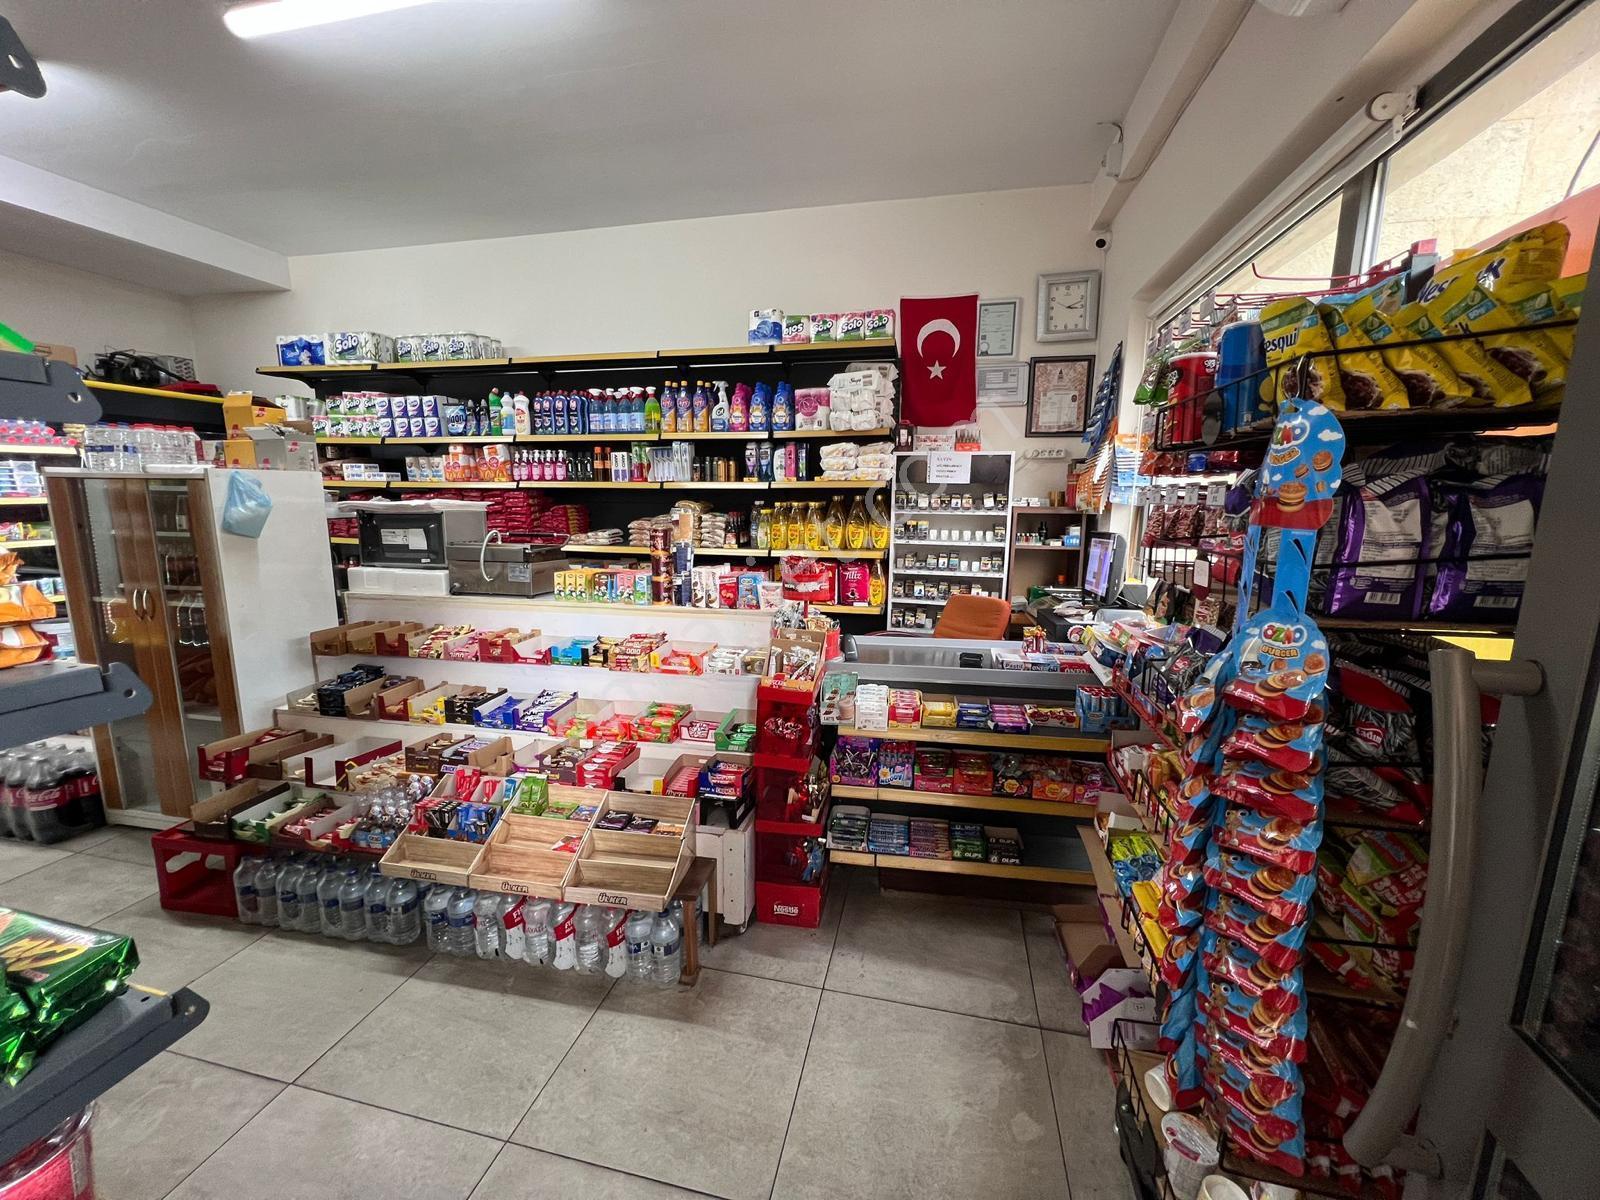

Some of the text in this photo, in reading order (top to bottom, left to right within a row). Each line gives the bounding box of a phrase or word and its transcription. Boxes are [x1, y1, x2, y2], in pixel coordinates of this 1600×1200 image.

[813, 320, 833, 333] Solo
[842, 318, 863, 332] Solo
[867, 315, 889, 330] Solo
[335, 335, 359, 353] Solo
[422, 341, 440, 354] Solo
[449, 340, 465, 353] Solo
[364, 399, 376, 410] Sol
[501, 881, 528, 893] ÜLKER
[598, 892, 627, 905] ÜLKER
